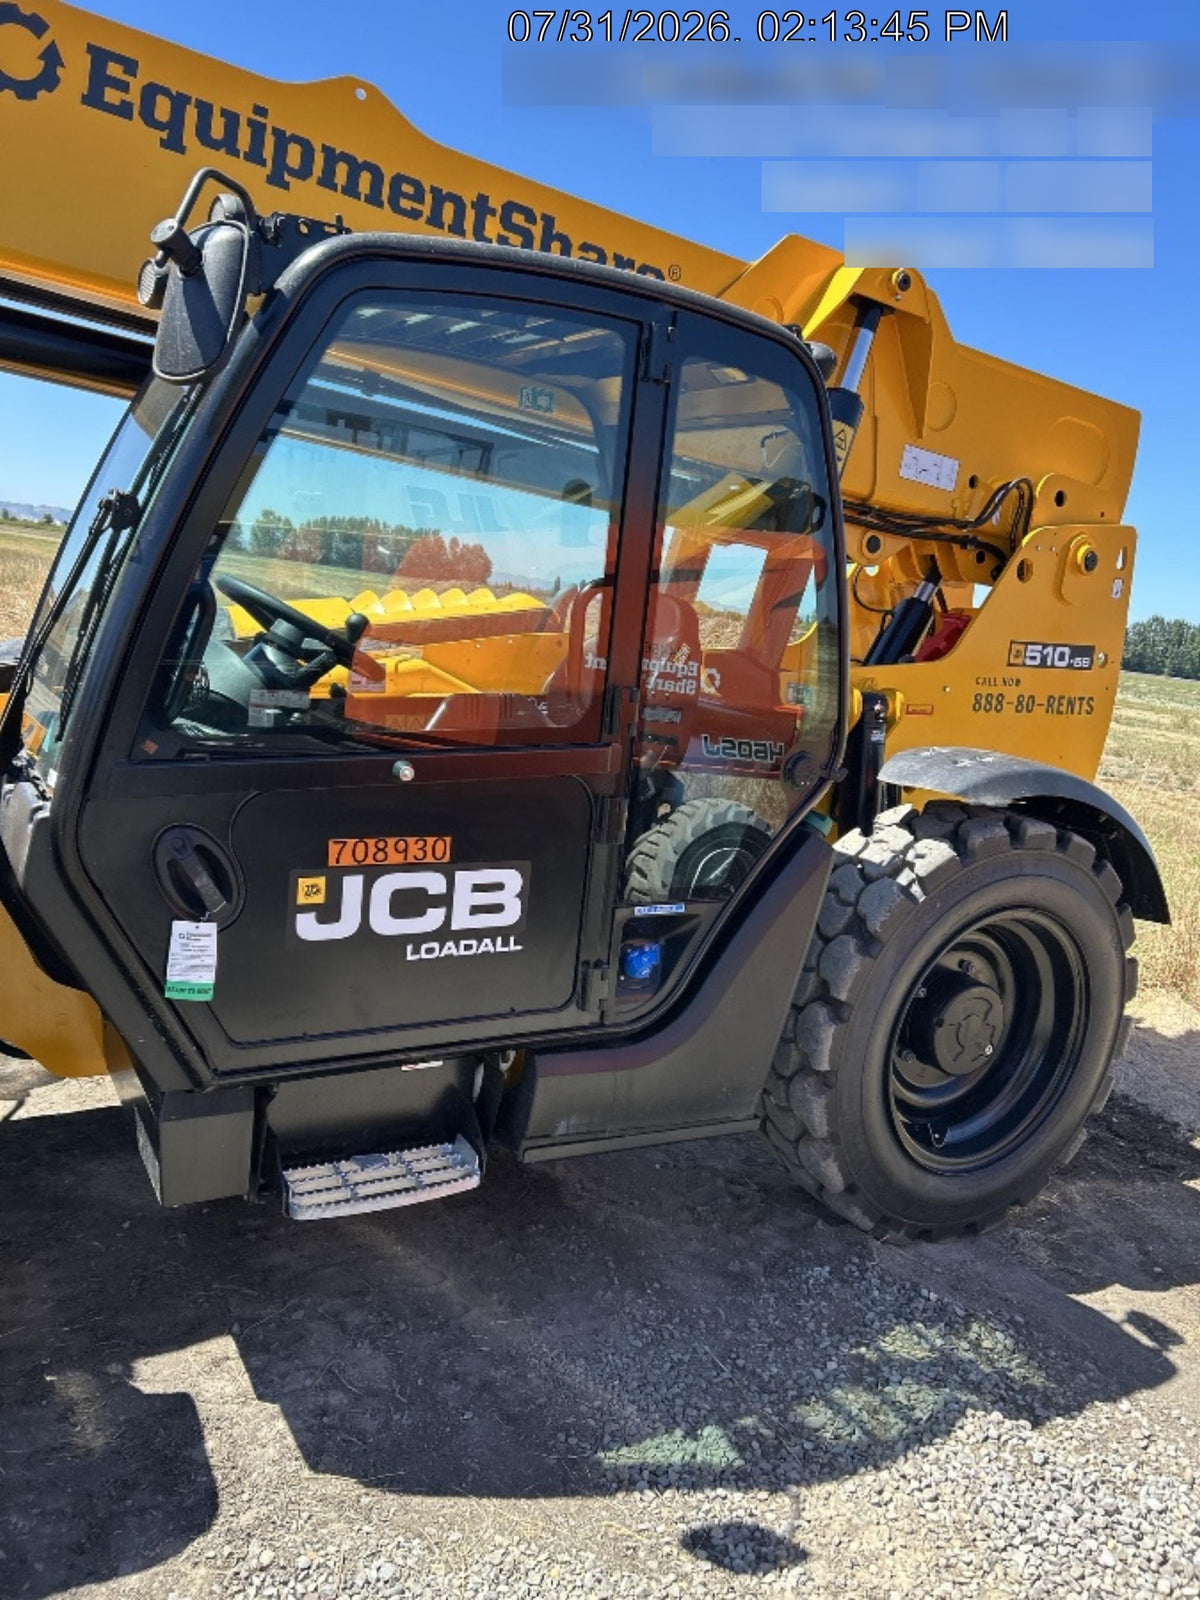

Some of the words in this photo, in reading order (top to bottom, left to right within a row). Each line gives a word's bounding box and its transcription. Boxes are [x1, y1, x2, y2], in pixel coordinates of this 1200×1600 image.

[972, 693, 1094, 715] 888-80-RENTS
[332, 838, 448, 864] 708930
[296, 869, 523, 941] JCB
[406, 936, 523, 961] LOADALL
